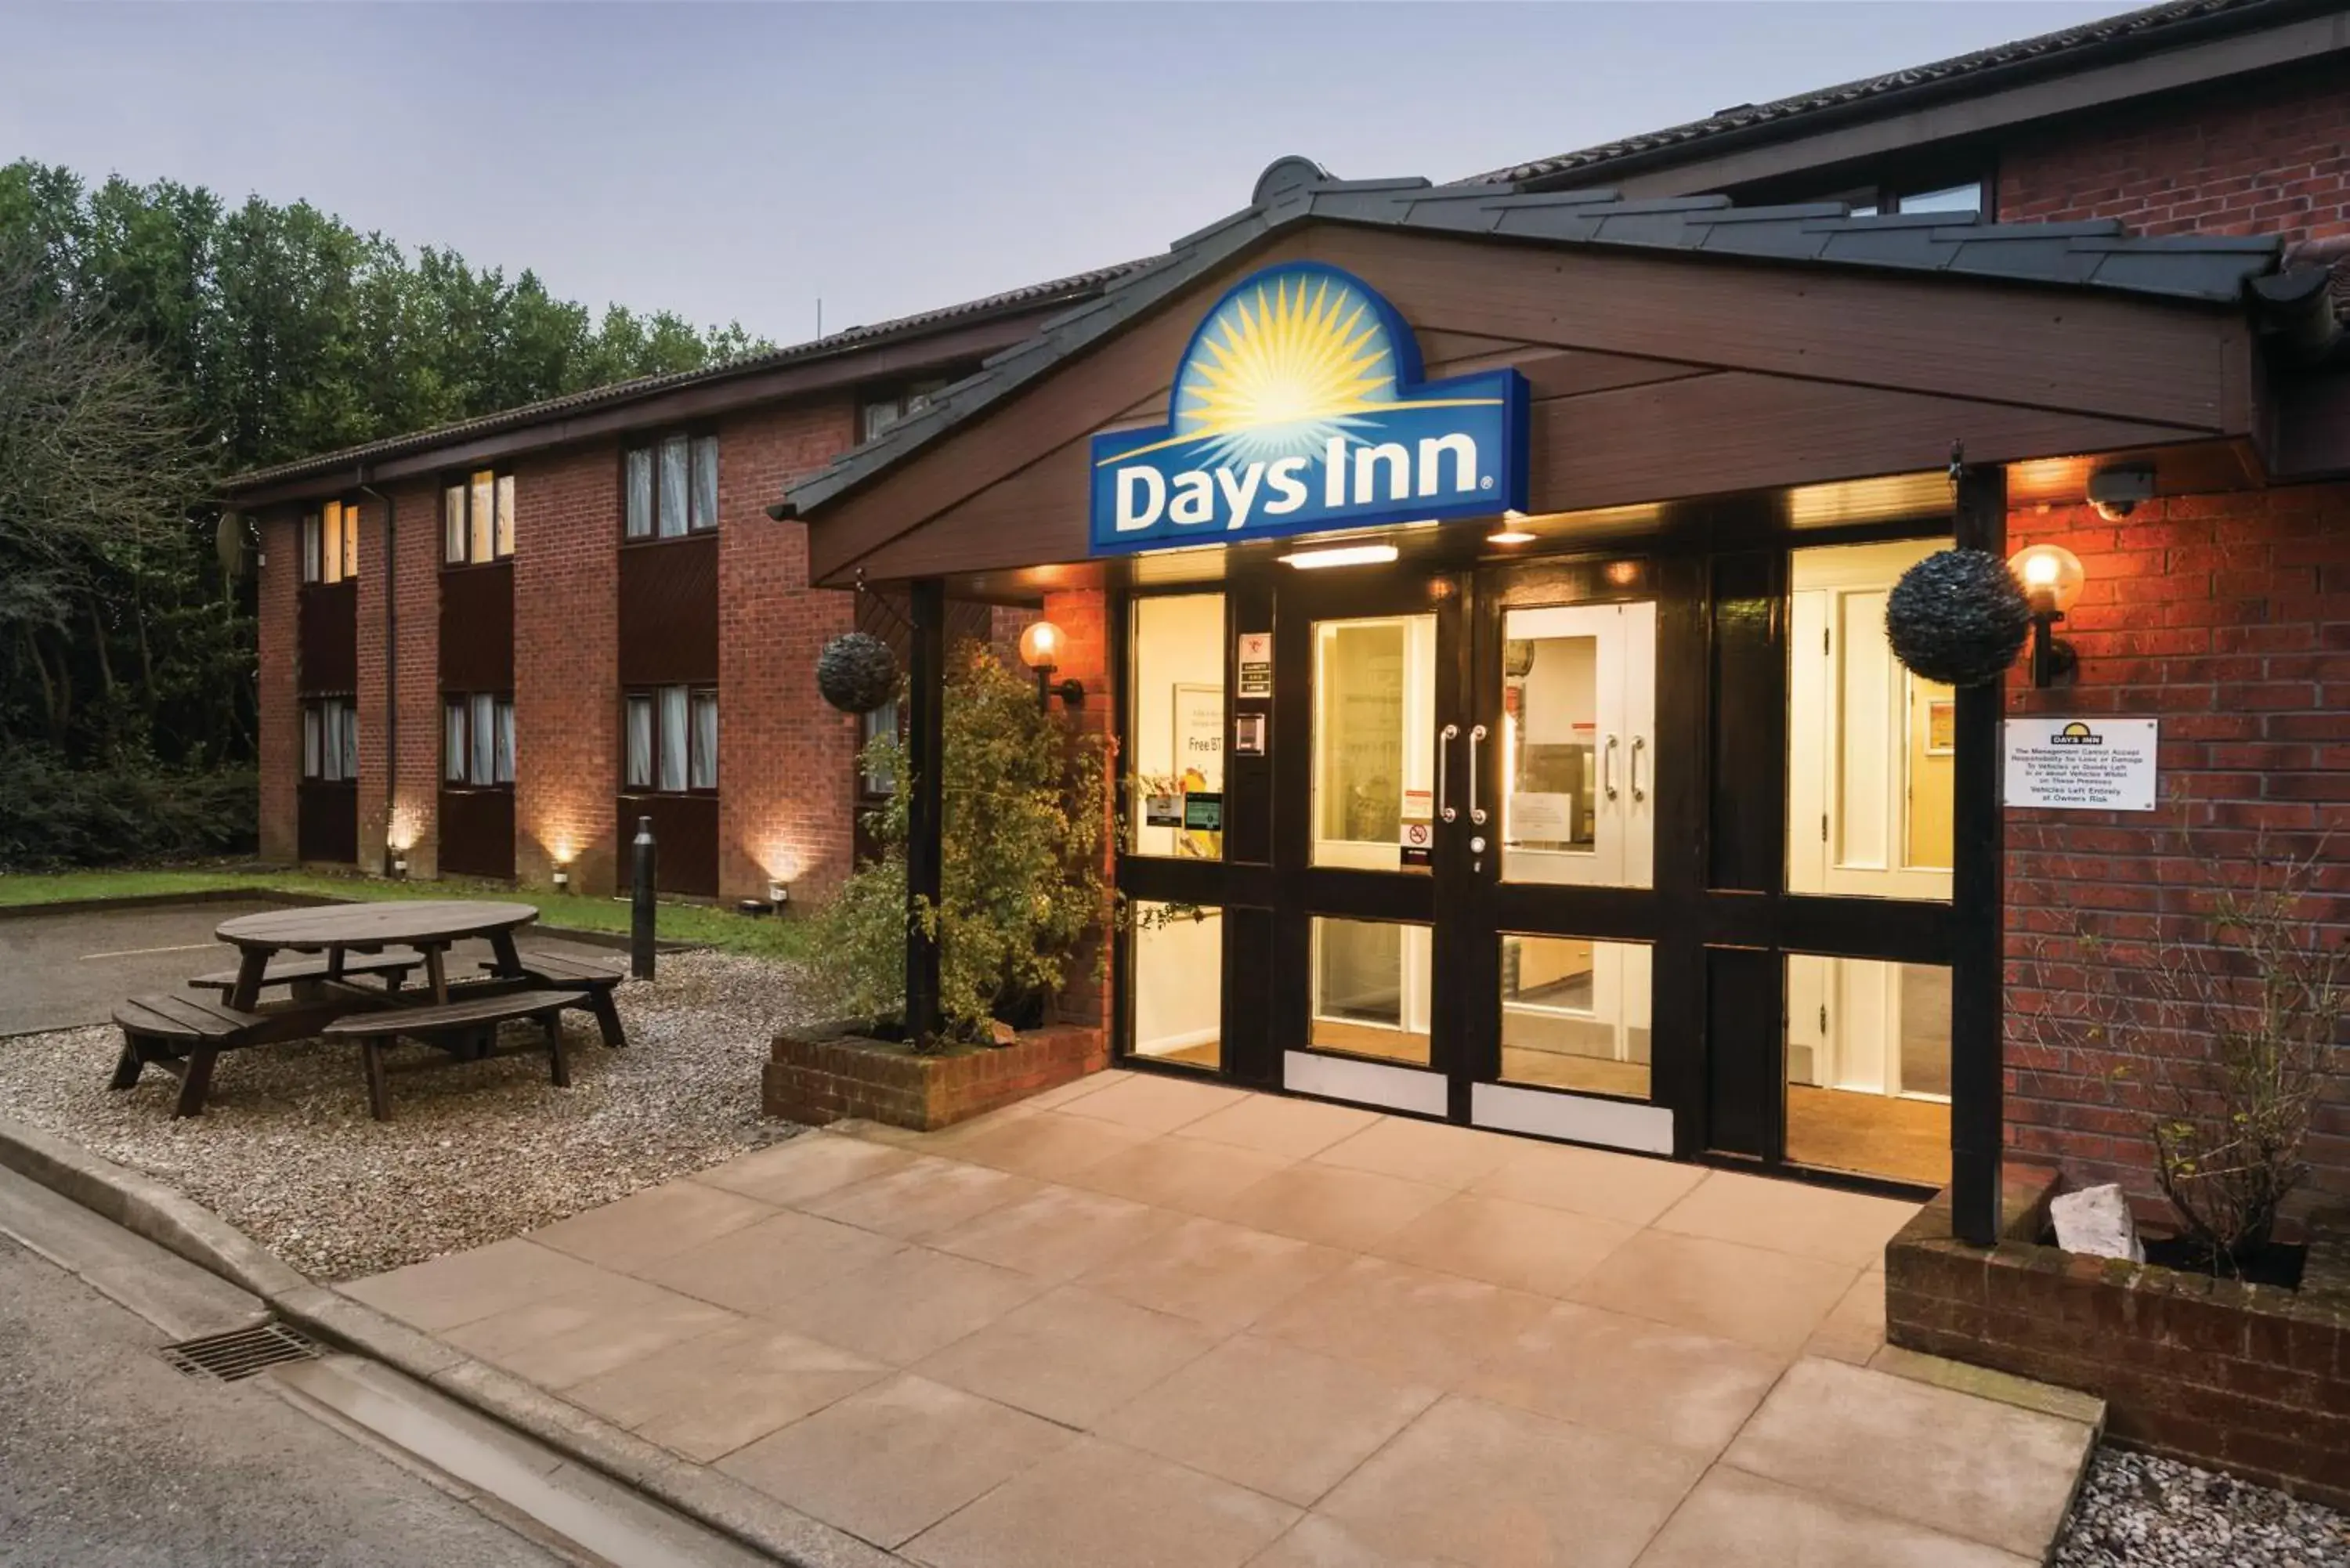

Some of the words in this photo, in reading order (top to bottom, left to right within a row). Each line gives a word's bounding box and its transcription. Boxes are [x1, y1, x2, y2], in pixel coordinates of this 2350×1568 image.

[1116, 457, 1308, 532] Days
[1325, 432, 1477, 508] Inn
[1189, 737, 1209, 752] Free
[2011, 754, 2063, 763] Responsibility
[2111, 756, 2143, 764] Damage
[2110, 763, 2127, 771] Left
[2088, 788, 2121, 797] Entirely
